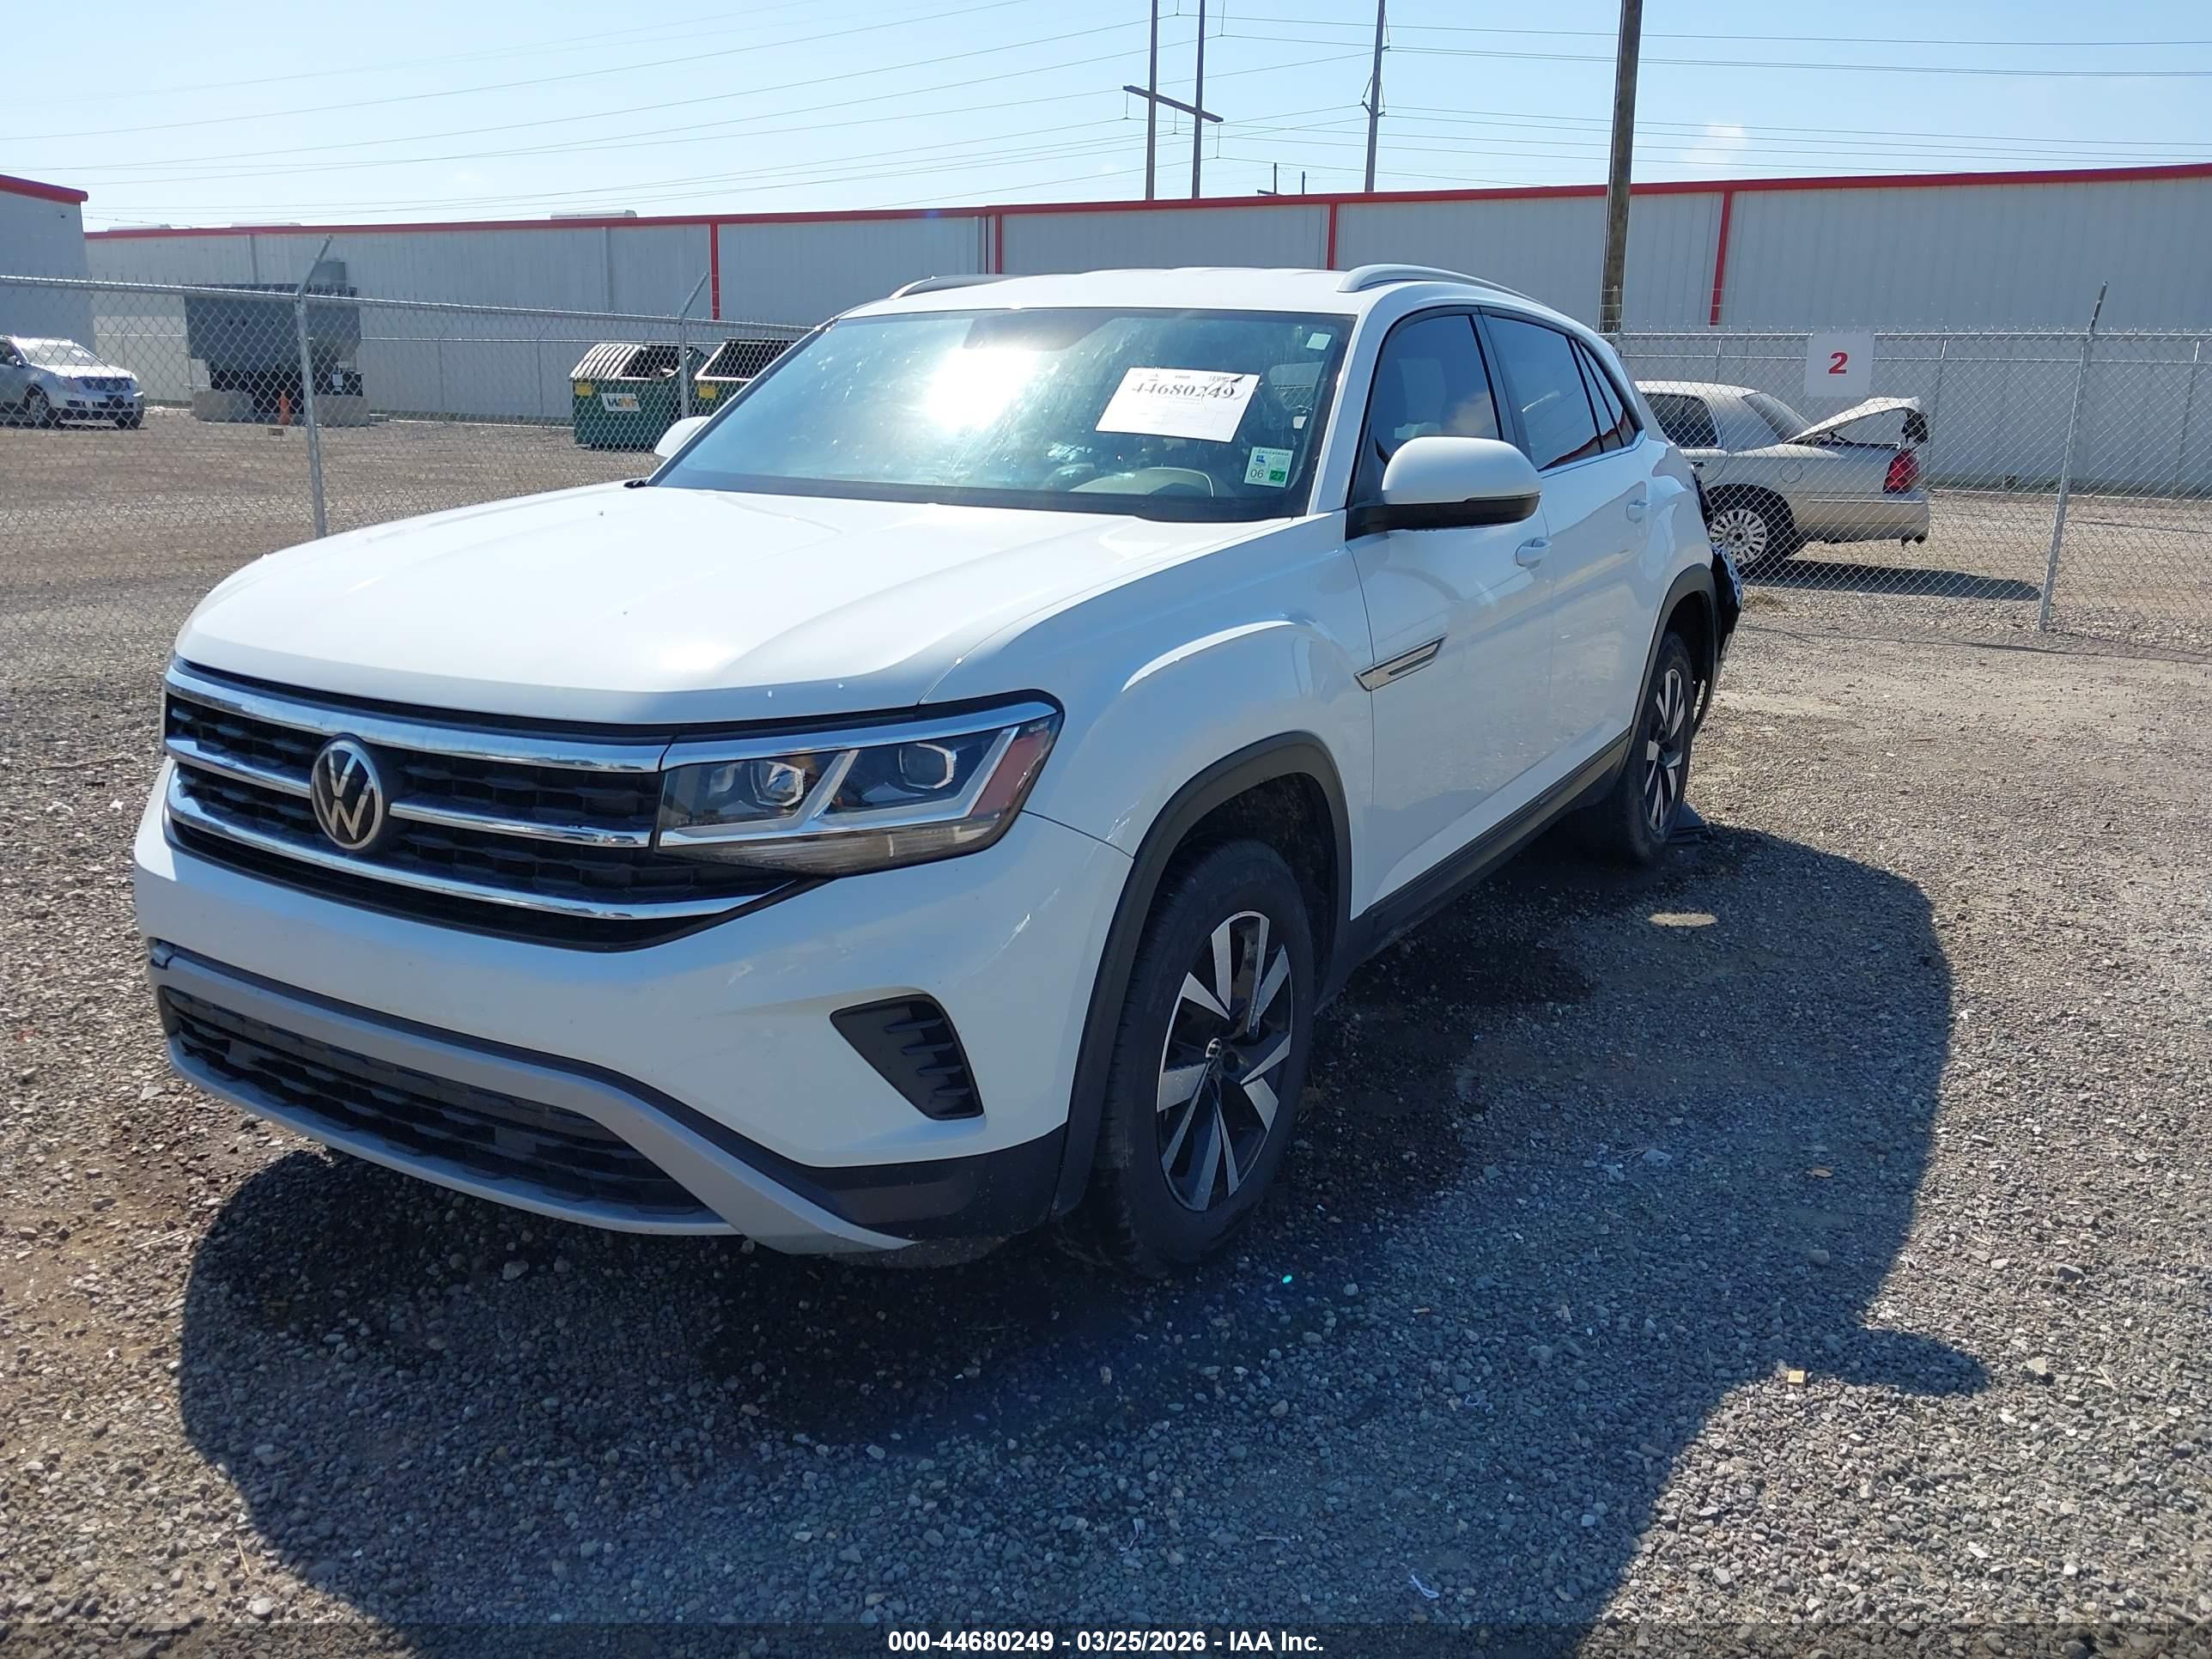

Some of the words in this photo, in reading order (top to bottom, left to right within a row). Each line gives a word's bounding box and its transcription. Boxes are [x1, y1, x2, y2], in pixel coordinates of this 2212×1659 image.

[1828, 351, 1848, 374] 2
[1132, 381, 1237, 400] 44680249
[1250, 469, 1264, 479] 06
